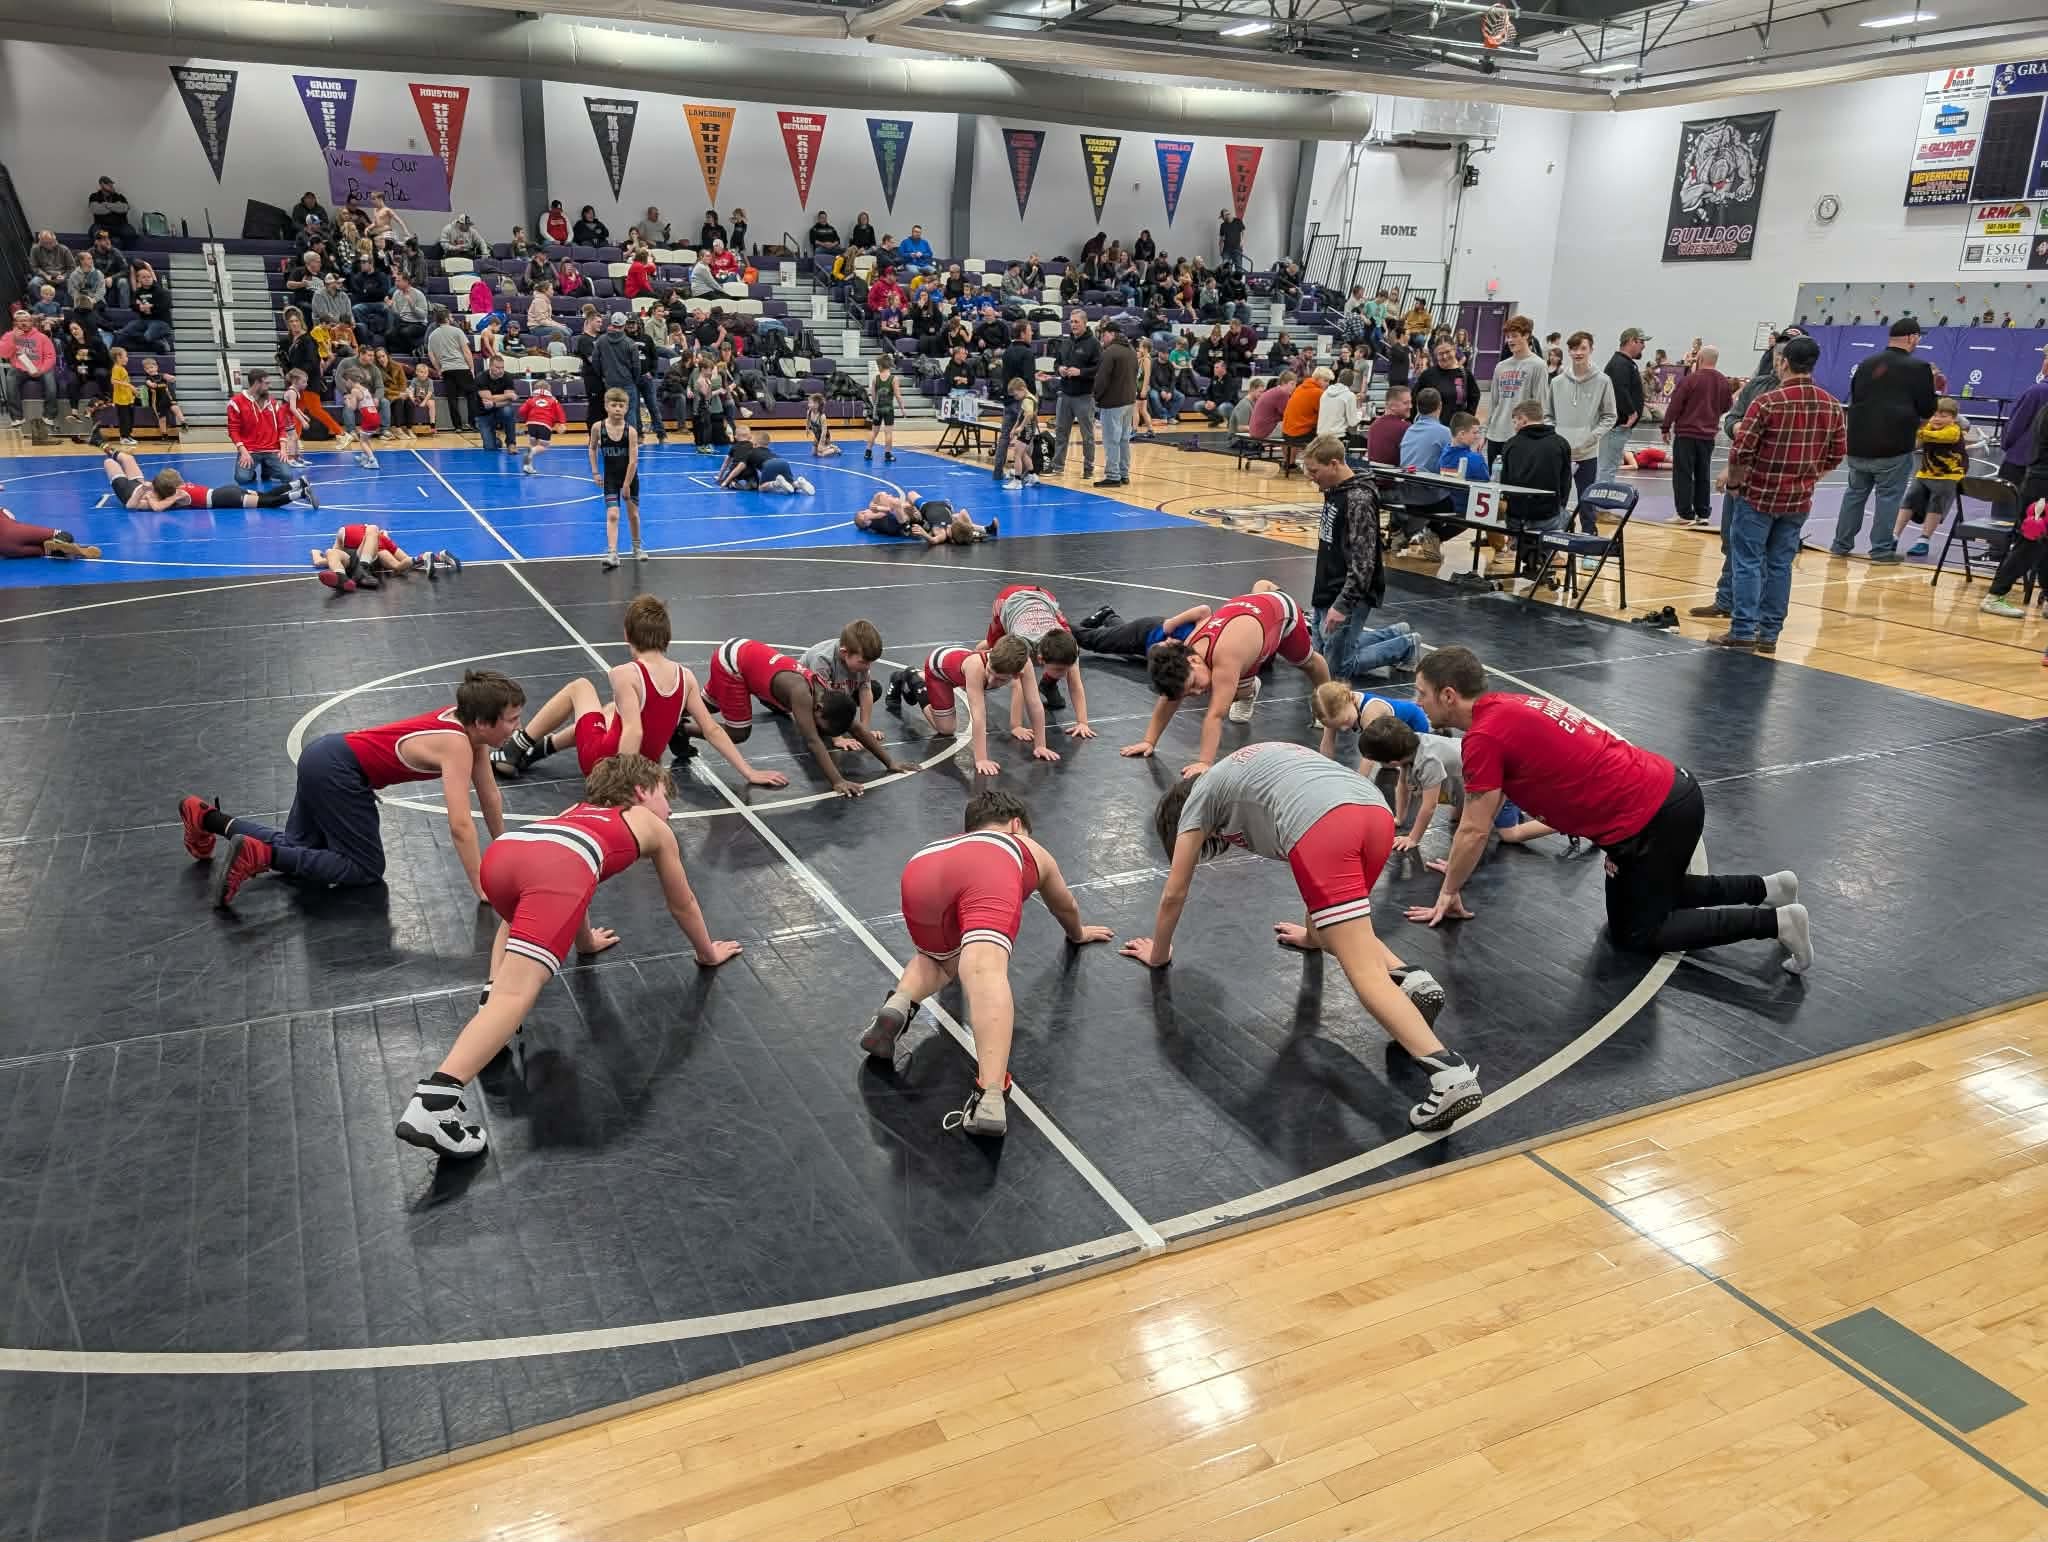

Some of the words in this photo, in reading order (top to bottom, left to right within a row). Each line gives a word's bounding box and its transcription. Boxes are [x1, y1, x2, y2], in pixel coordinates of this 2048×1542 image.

[309, 80, 342, 91] GRAND
[305, 89, 347, 100] MEADOW
[420, 88, 460, 99] HOUSTON
[700, 122, 721, 186] BURROS
[330, 152, 351, 168] We
[391, 157, 418, 173] Our
[1091, 154, 1110, 206] LIONS
[1977, 206, 2013, 219] LRM
[1380, 225, 1418, 237] HOME
[1668, 225, 1753, 246] BULLDOG
[1986, 243, 2029, 255] ESSIG
[1985, 255, 2026, 264] AGENCY
[943, 400, 950, 416] 6
[1474, 491, 1491, 518] 5
